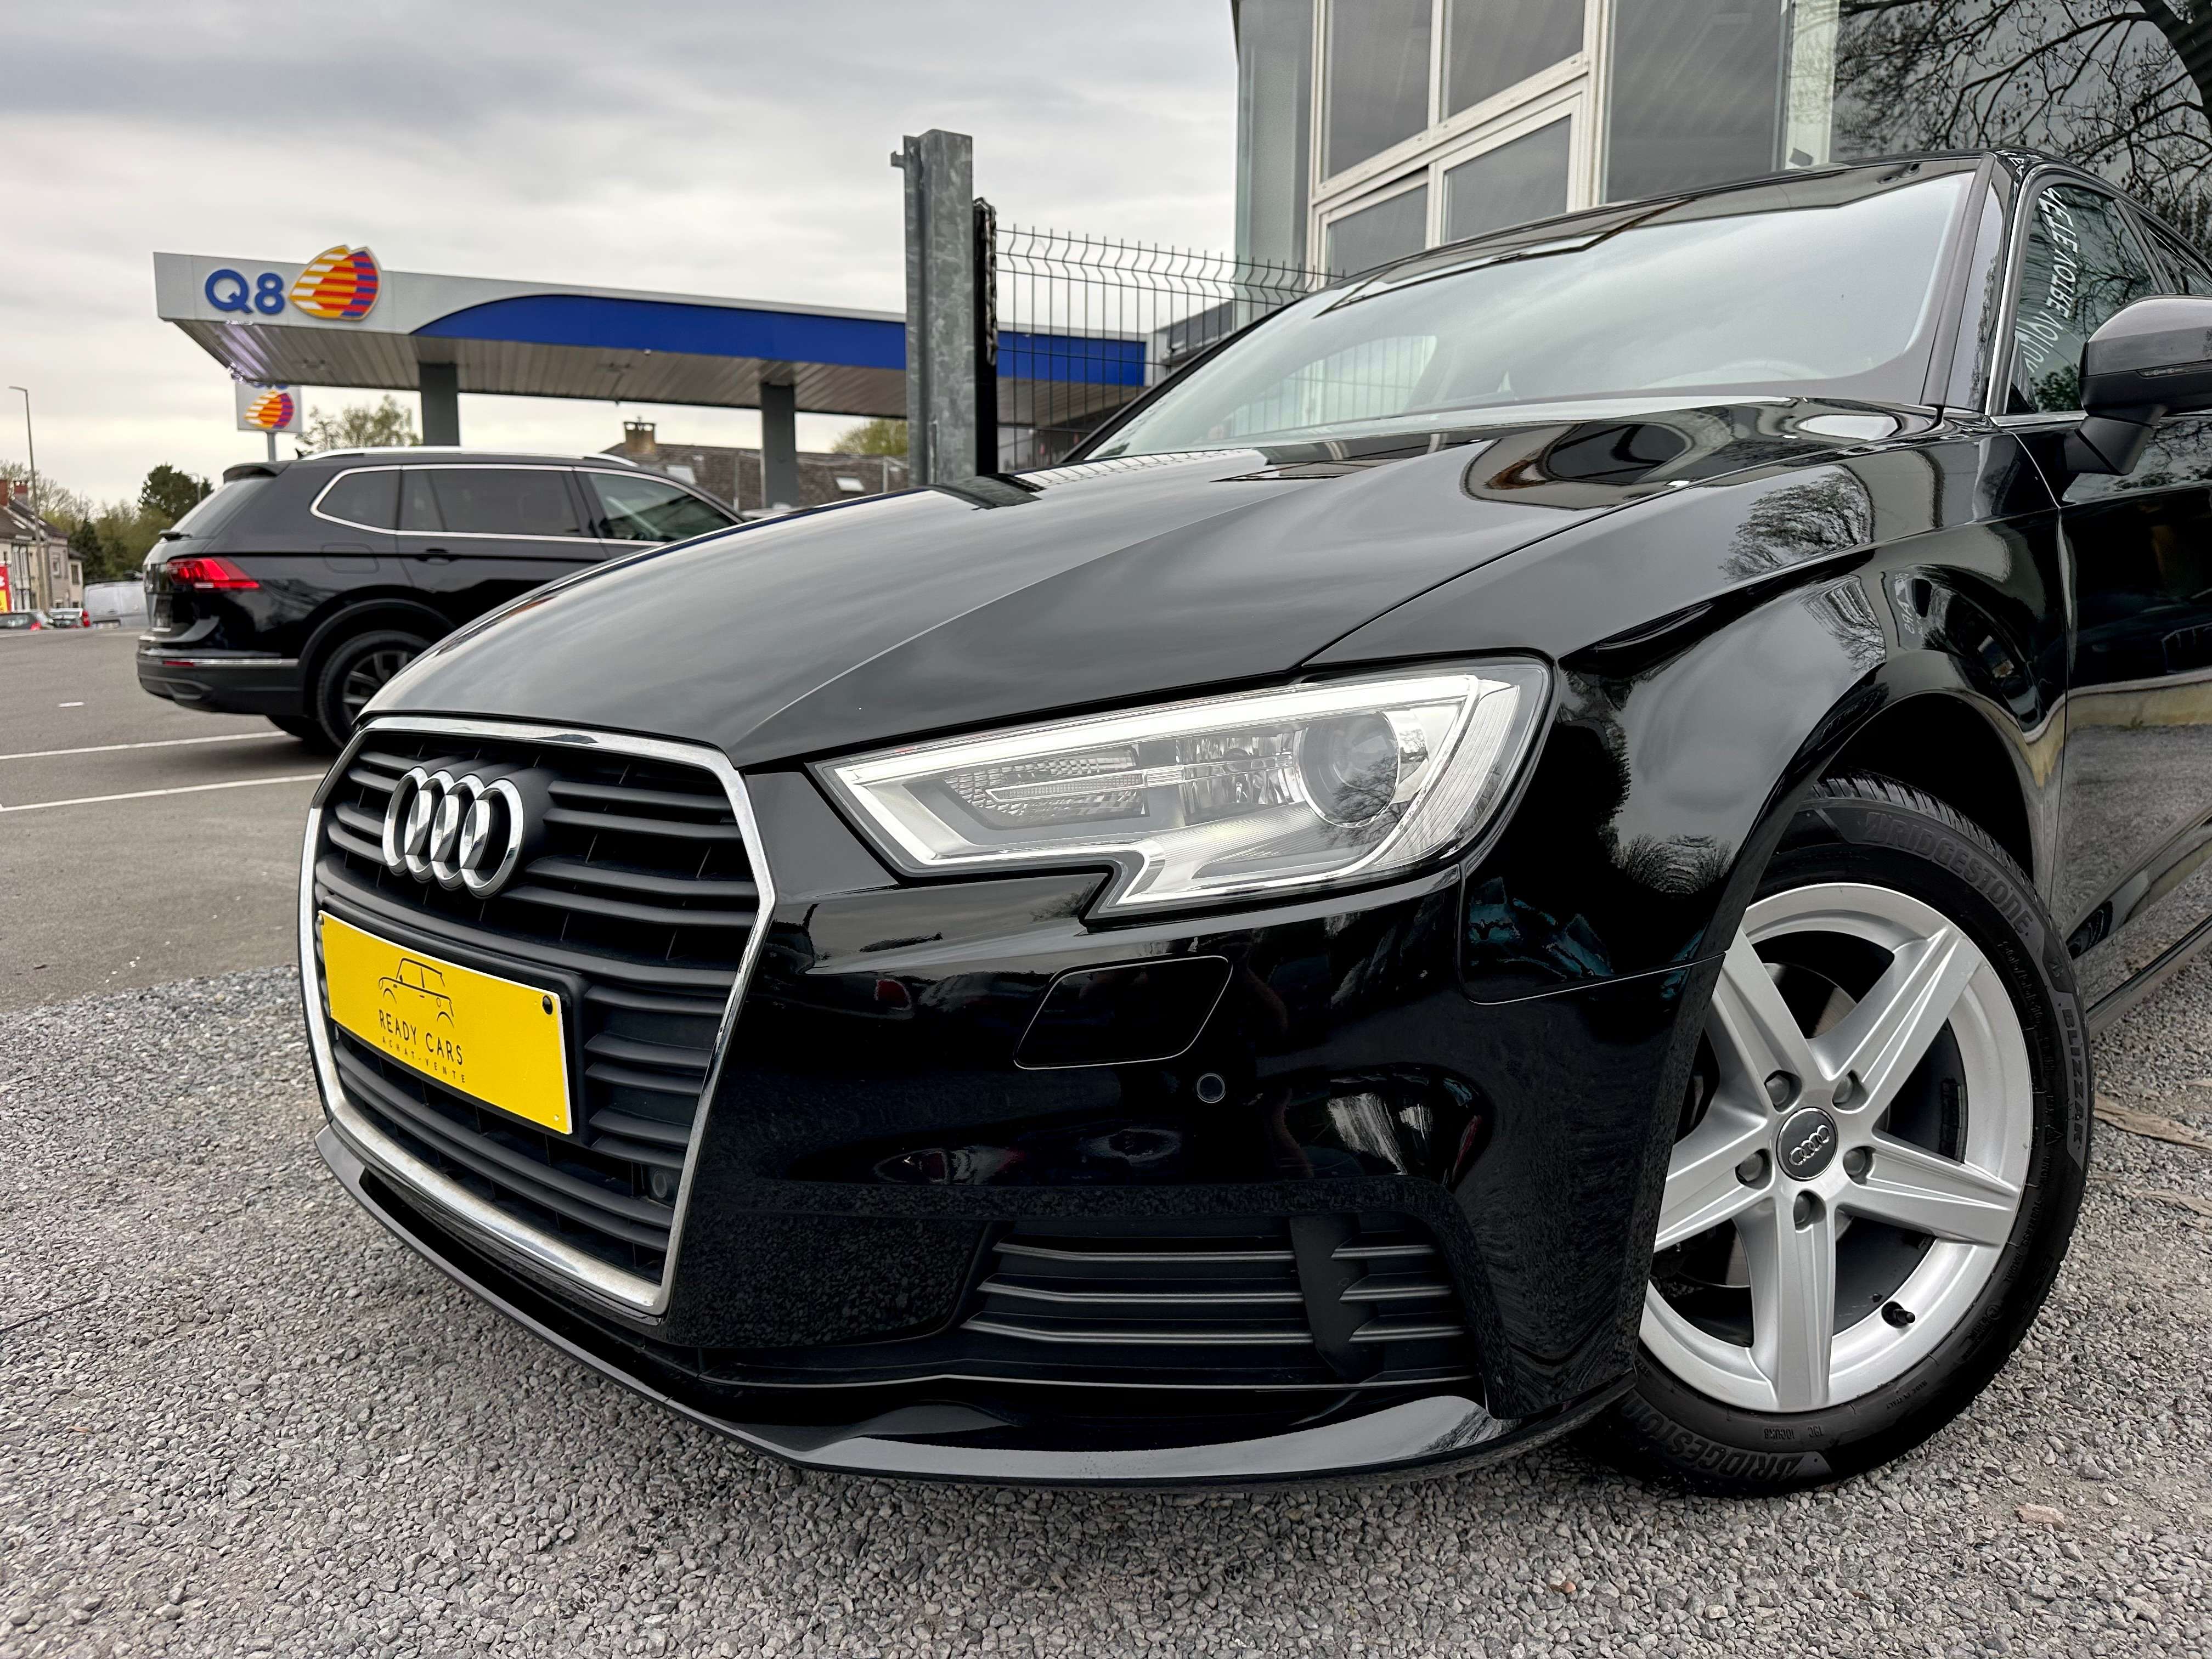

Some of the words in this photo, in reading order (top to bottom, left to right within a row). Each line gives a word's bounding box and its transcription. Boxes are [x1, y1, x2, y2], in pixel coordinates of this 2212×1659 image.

[205, 269, 285, 315] Q8
[1865, 812, 2033, 928] BRIDGESTONE
[379, 1009, 417, 1045] READY
[425, 1032, 463, 1065] CARS
[2062, 1008, 2084, 1144] BLIZZAK
